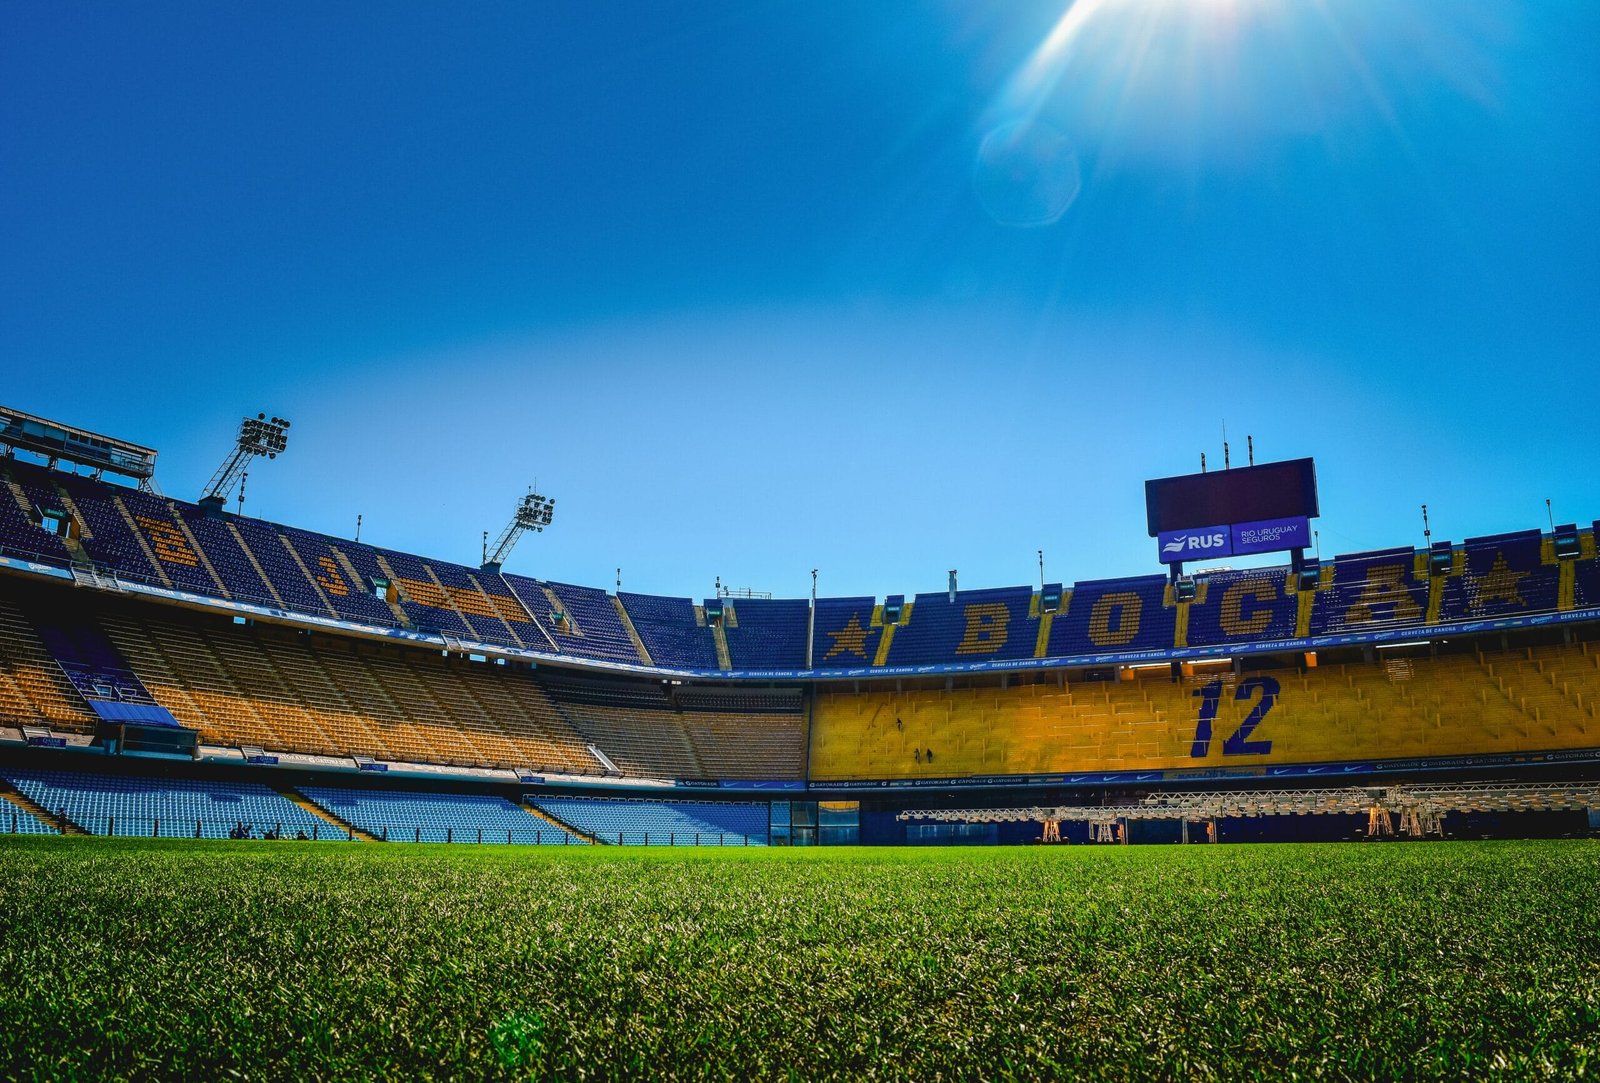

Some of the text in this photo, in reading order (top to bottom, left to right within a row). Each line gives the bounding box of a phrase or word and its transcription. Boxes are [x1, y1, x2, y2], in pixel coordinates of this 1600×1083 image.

[1241, 525, 1298, 539] RIO URUGUAY
[1189, 533, 1225, 550] RUS
[1241, 534, 1281, 546] SEGUROS
[1560, 612, 1587, 620] CERVEZA
[1401, 629, 1425, 637] CERVEZA
[1434, 626, 1457, 634] CANCHA
[1190, 675, 1281, 758] 12
